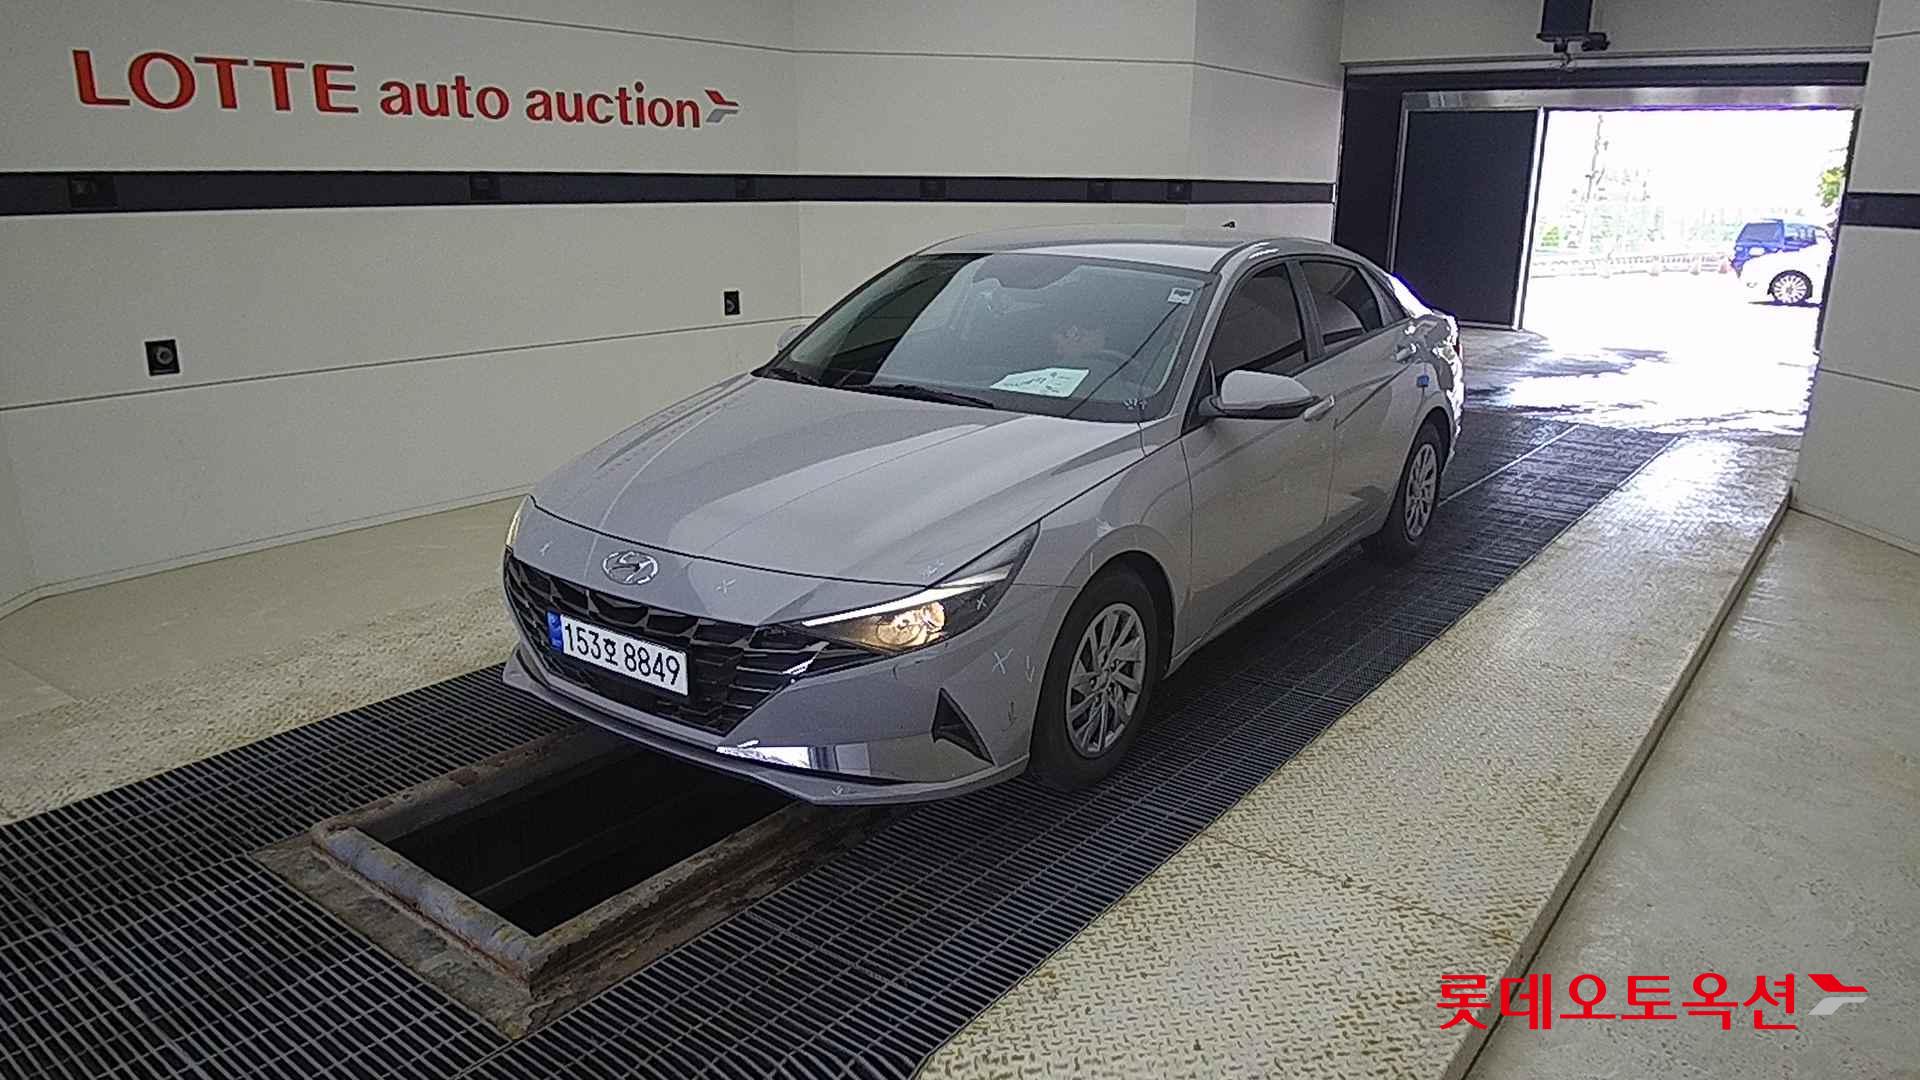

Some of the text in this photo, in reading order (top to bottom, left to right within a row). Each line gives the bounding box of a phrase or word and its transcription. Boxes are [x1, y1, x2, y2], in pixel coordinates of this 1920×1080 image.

[72, 49, 701, 128] LOTTE auto auction
[564, 623, 680, 686] 153호 8849
